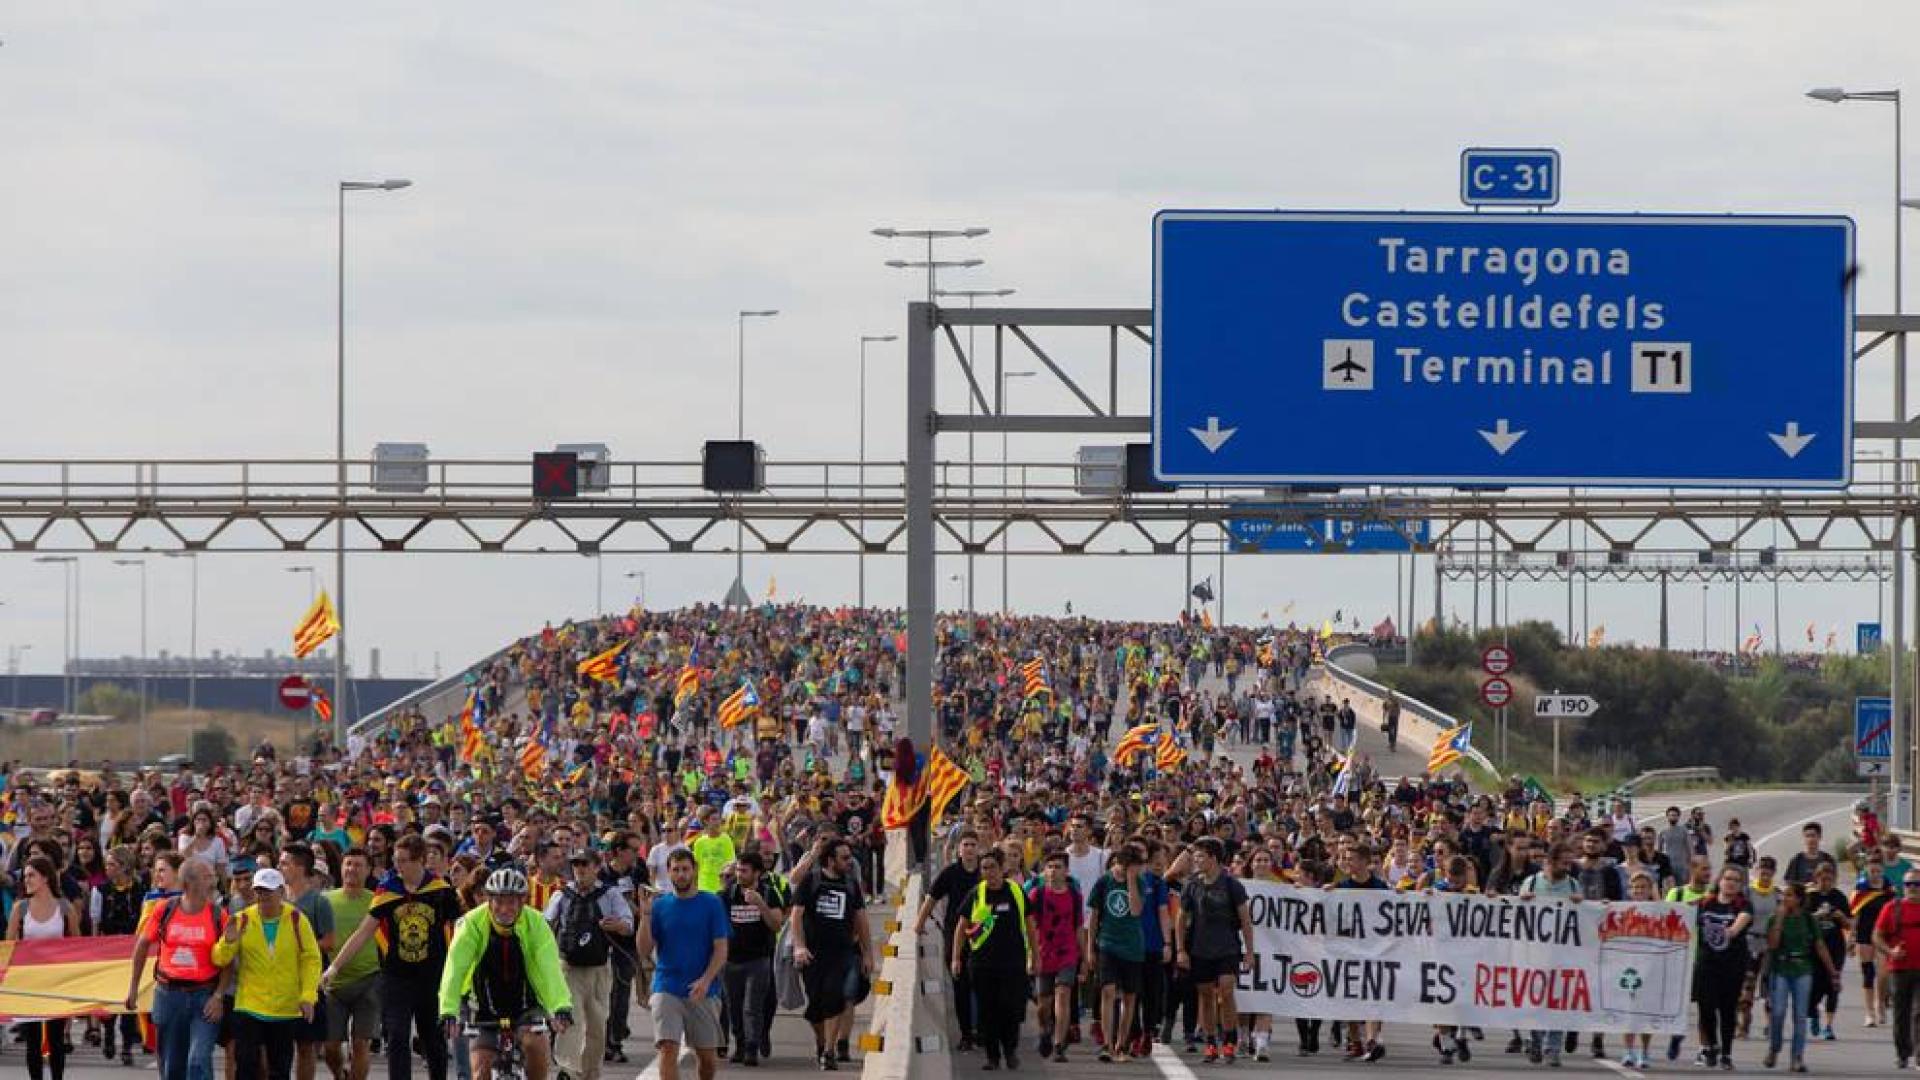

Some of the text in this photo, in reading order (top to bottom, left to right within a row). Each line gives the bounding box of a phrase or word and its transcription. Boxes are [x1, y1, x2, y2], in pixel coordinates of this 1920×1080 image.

[1474, 164, 1549, 191] C-31
[1380, 238, 1630, 285] Tarragona
[1343, 293, 1664, 328] Castelldefels
[1396, 348, 1683, 384] Terminal T1
[1561, 699, 1589, 713] 190
[1249, 894, 1327, 936] ONTRA
[1336, 902, 1366, 938] LA
[1372, 902, 1432, 937] SEVA
[1420, 962, 1457, 1004] ES
[1475, 963, 1592, 1012] REVOLTA
